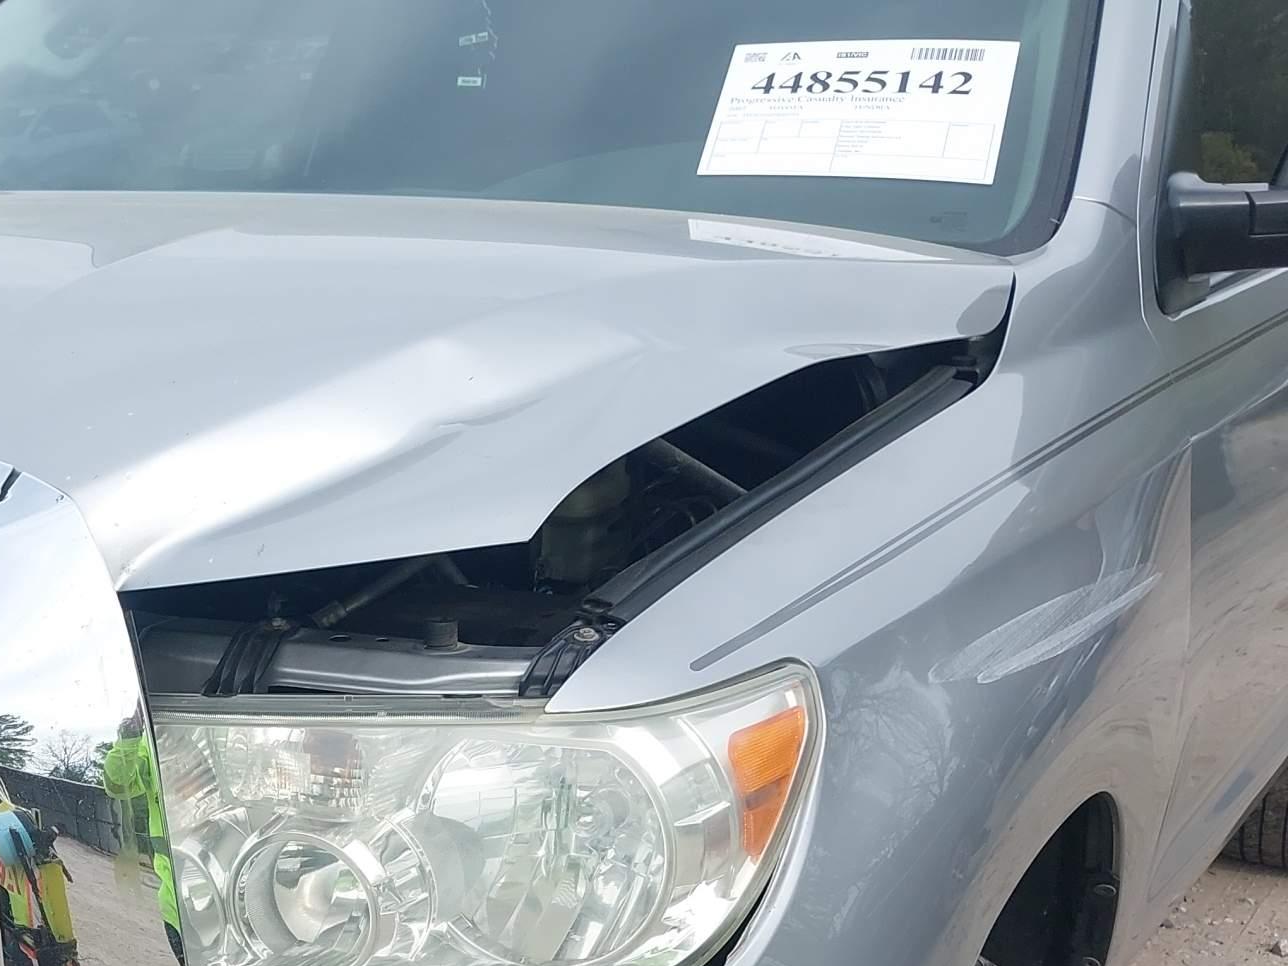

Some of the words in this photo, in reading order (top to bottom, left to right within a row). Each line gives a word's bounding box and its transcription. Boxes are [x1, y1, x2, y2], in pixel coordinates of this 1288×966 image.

[751, 69, 974, 95] 44855142
[730, 96, 795, 105] Progressive
[797, 95, 844, 104] Casualty
[850, 95, 905, 103] Insurance
